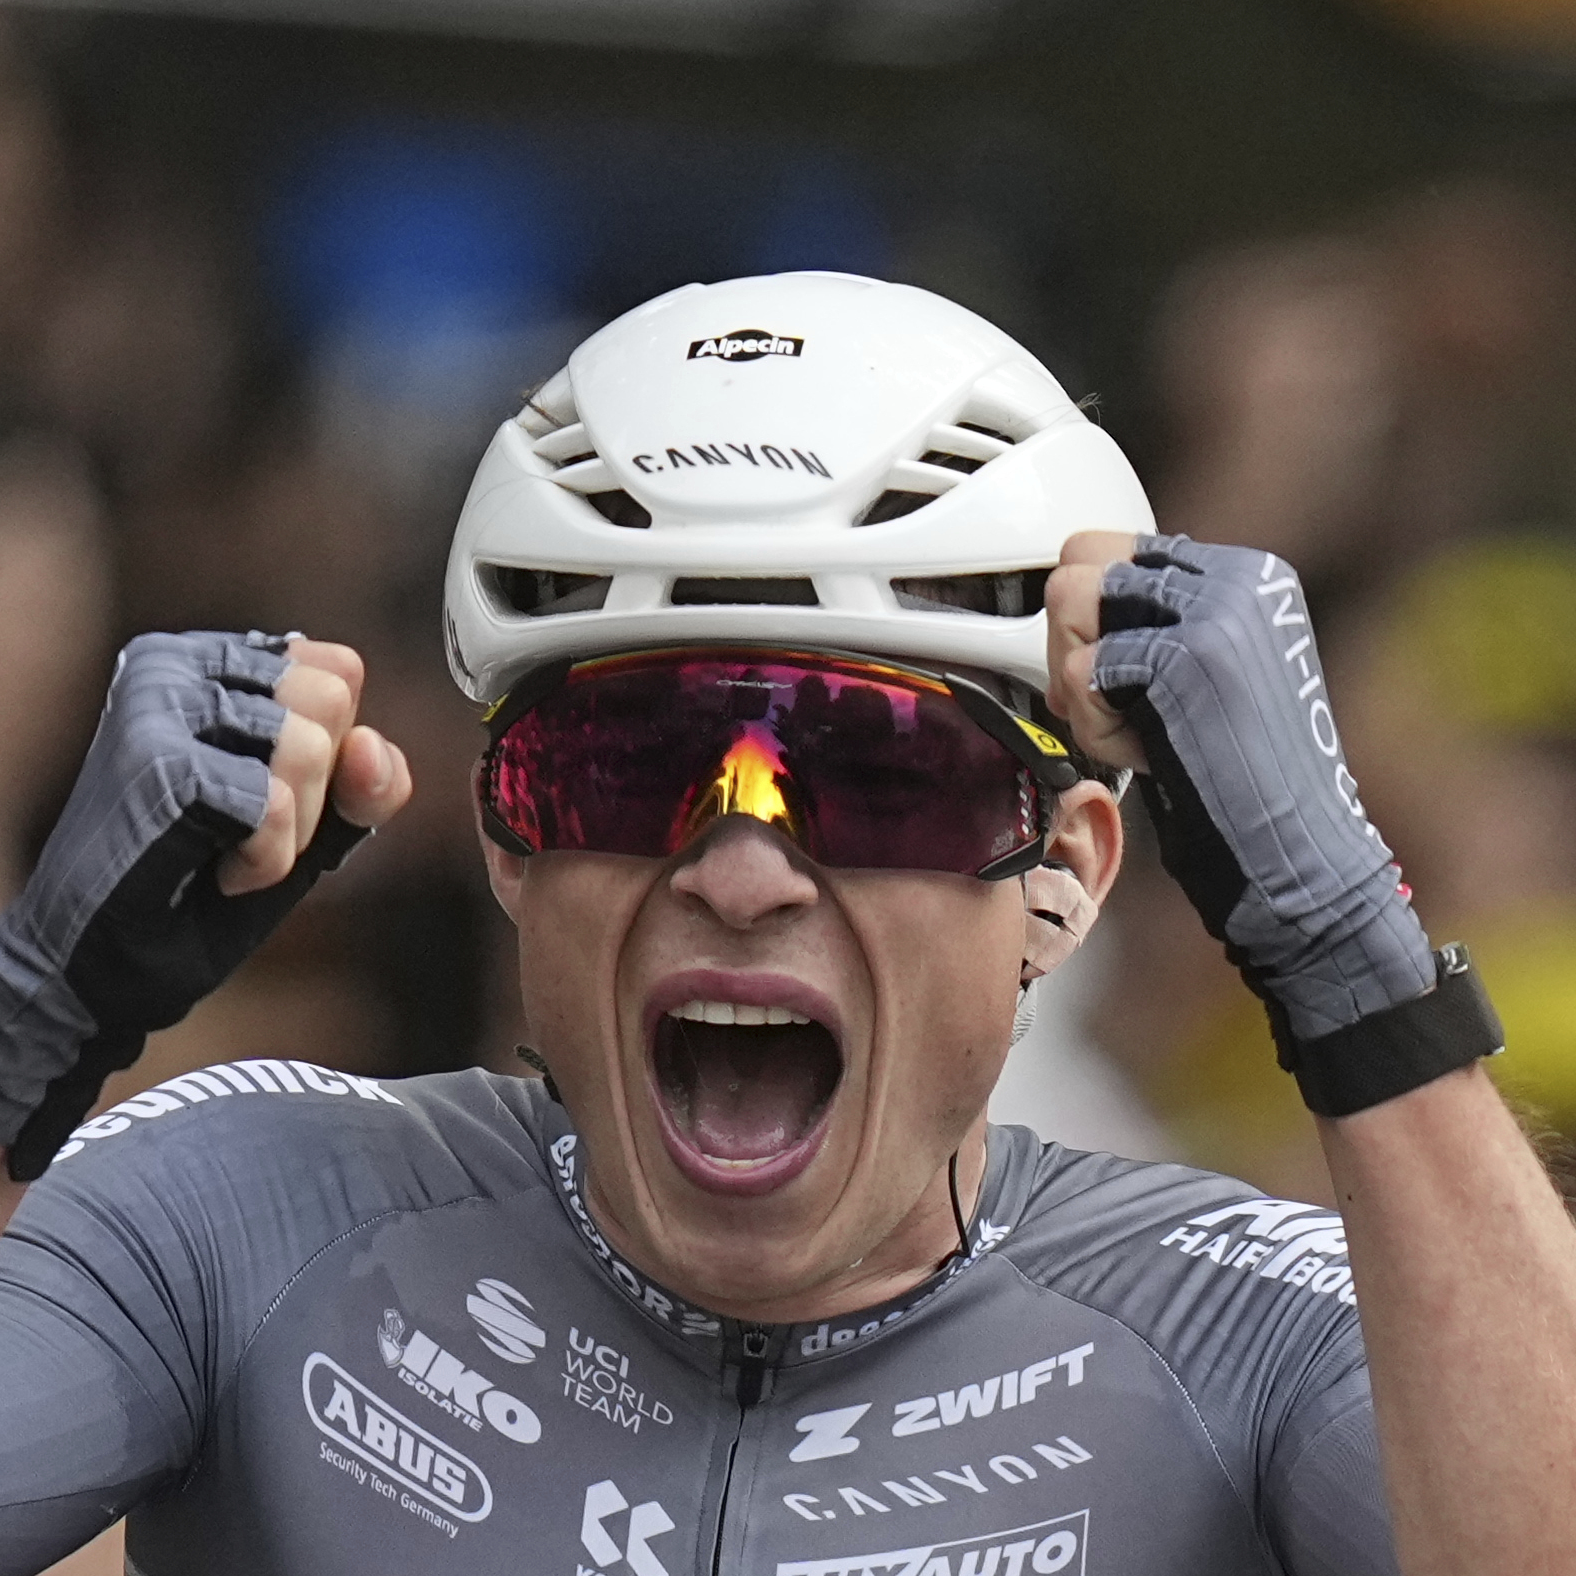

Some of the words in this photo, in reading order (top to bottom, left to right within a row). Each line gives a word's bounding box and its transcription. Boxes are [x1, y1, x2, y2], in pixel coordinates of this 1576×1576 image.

[695, 336, 795, 358] Alpecin
[632, 442, 834, 481] CANYON
[400, 1329, 543, 1445] IKO
[565, 1349, 674, 1426] WORLD
[569, 1327, 629, 1377] UCI
[891, 1341, 1095, 1438] ZWIFT
[397, 1366, 485, 1433] ISOLATIE
[561, 1372, 643, 1435] TEAM
[323, 1379, 469, 1505] ABUS
[782, 1435, 1094, 1521] CANYON
[319, 1441, 369, 1487] Security
[369, 1472, 398, 1501] Tech
[400, 1491, 460, 1540] Germany
